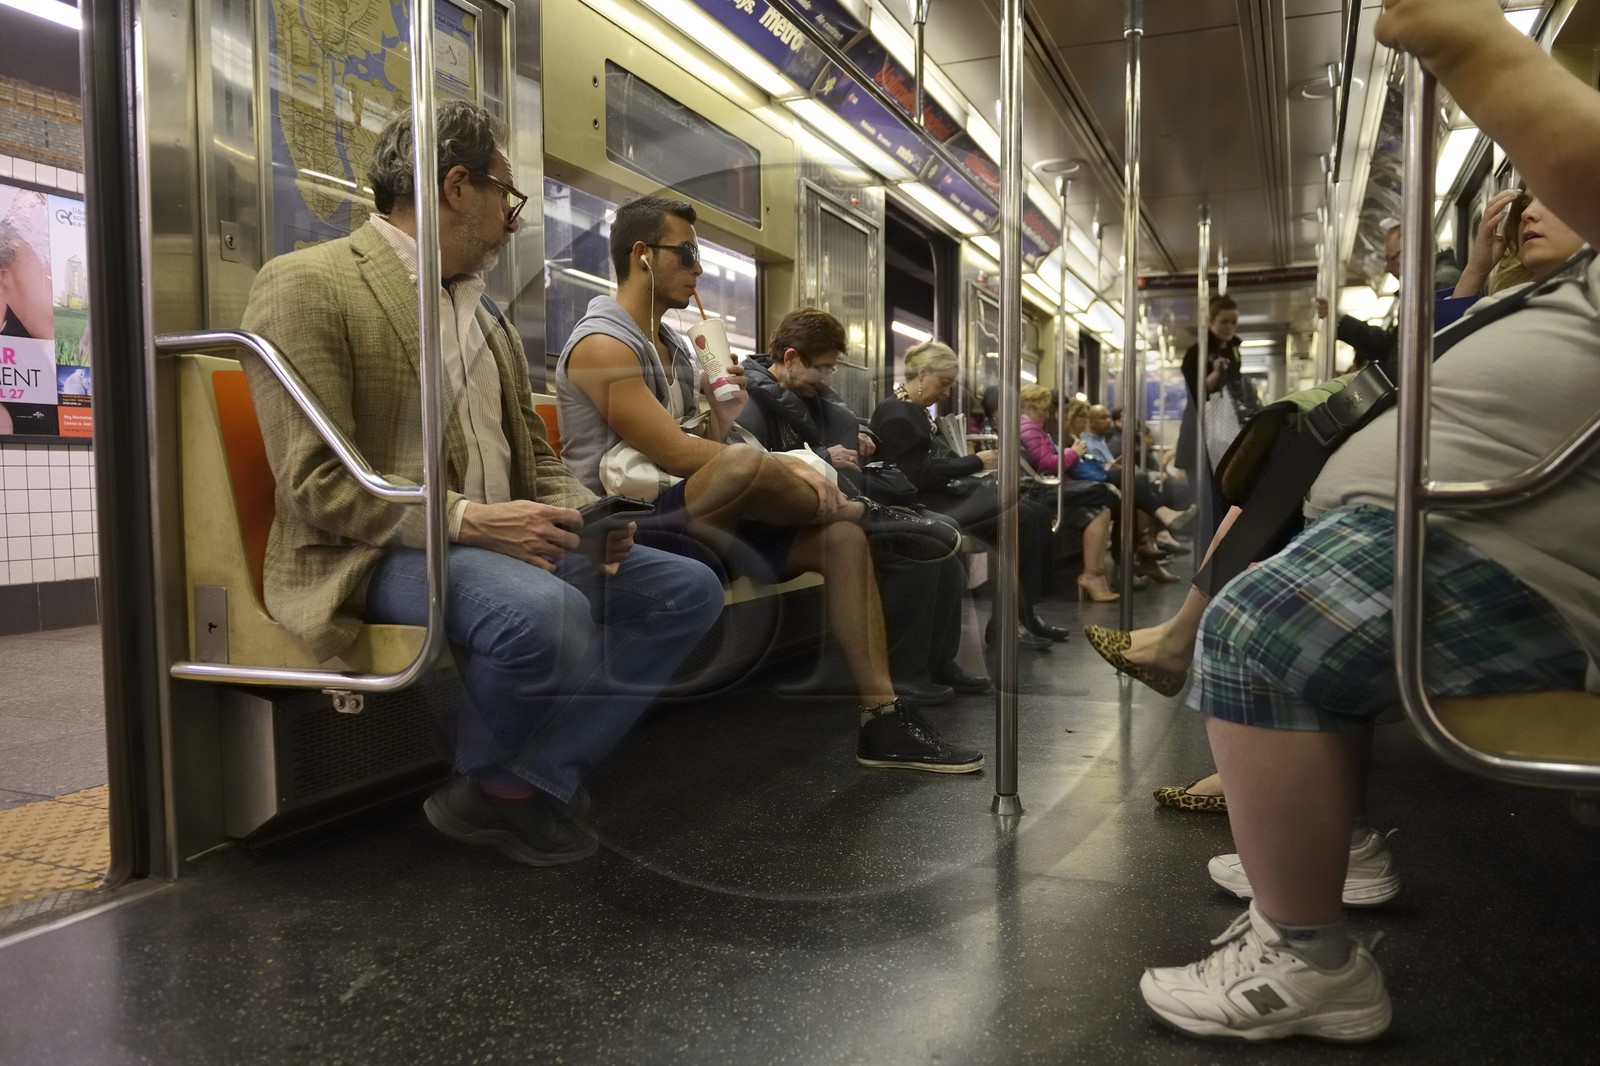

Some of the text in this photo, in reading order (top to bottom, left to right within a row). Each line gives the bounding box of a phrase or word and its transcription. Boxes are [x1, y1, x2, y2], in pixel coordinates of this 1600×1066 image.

[0, 367, 41, 388] ENT
[9, 388, 25, 399] 27
[1241, 983, 1289, 1017] N
